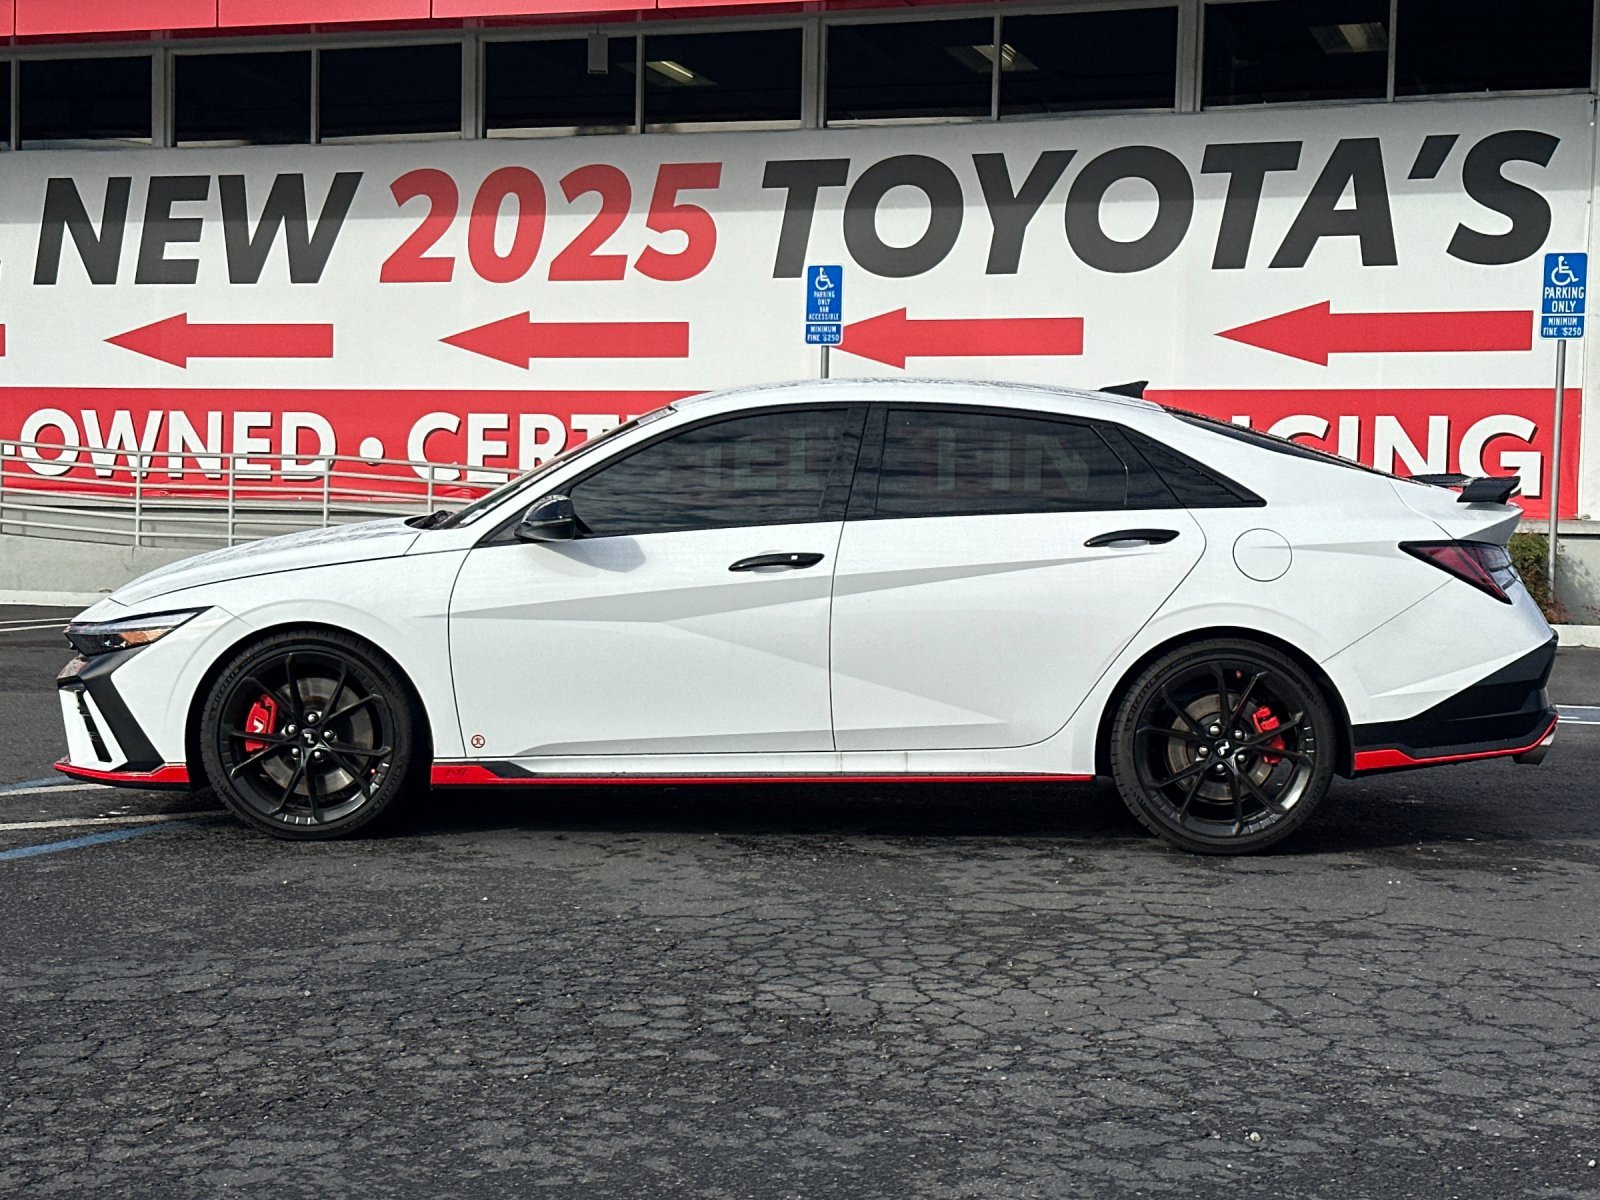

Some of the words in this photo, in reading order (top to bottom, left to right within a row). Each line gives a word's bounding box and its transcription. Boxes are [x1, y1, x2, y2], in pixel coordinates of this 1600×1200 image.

[33, 171, 363, 285] NEW
[380, 162, 722, 283] 2025
[762, 129, 1560, 279] TOYOTA'S
[1544, 286, 1585, 299] PARKING
[1551, 300, 1576, 313] ONLY
[1548, 317, 1578, 326] MINIMUM
[810, 325, 837, 333] MINIMUM
[1543, 326, 1557, 336] FINE
[1562, 326, 1582, 336] $250
[807, 334, 820, 342] FINE
